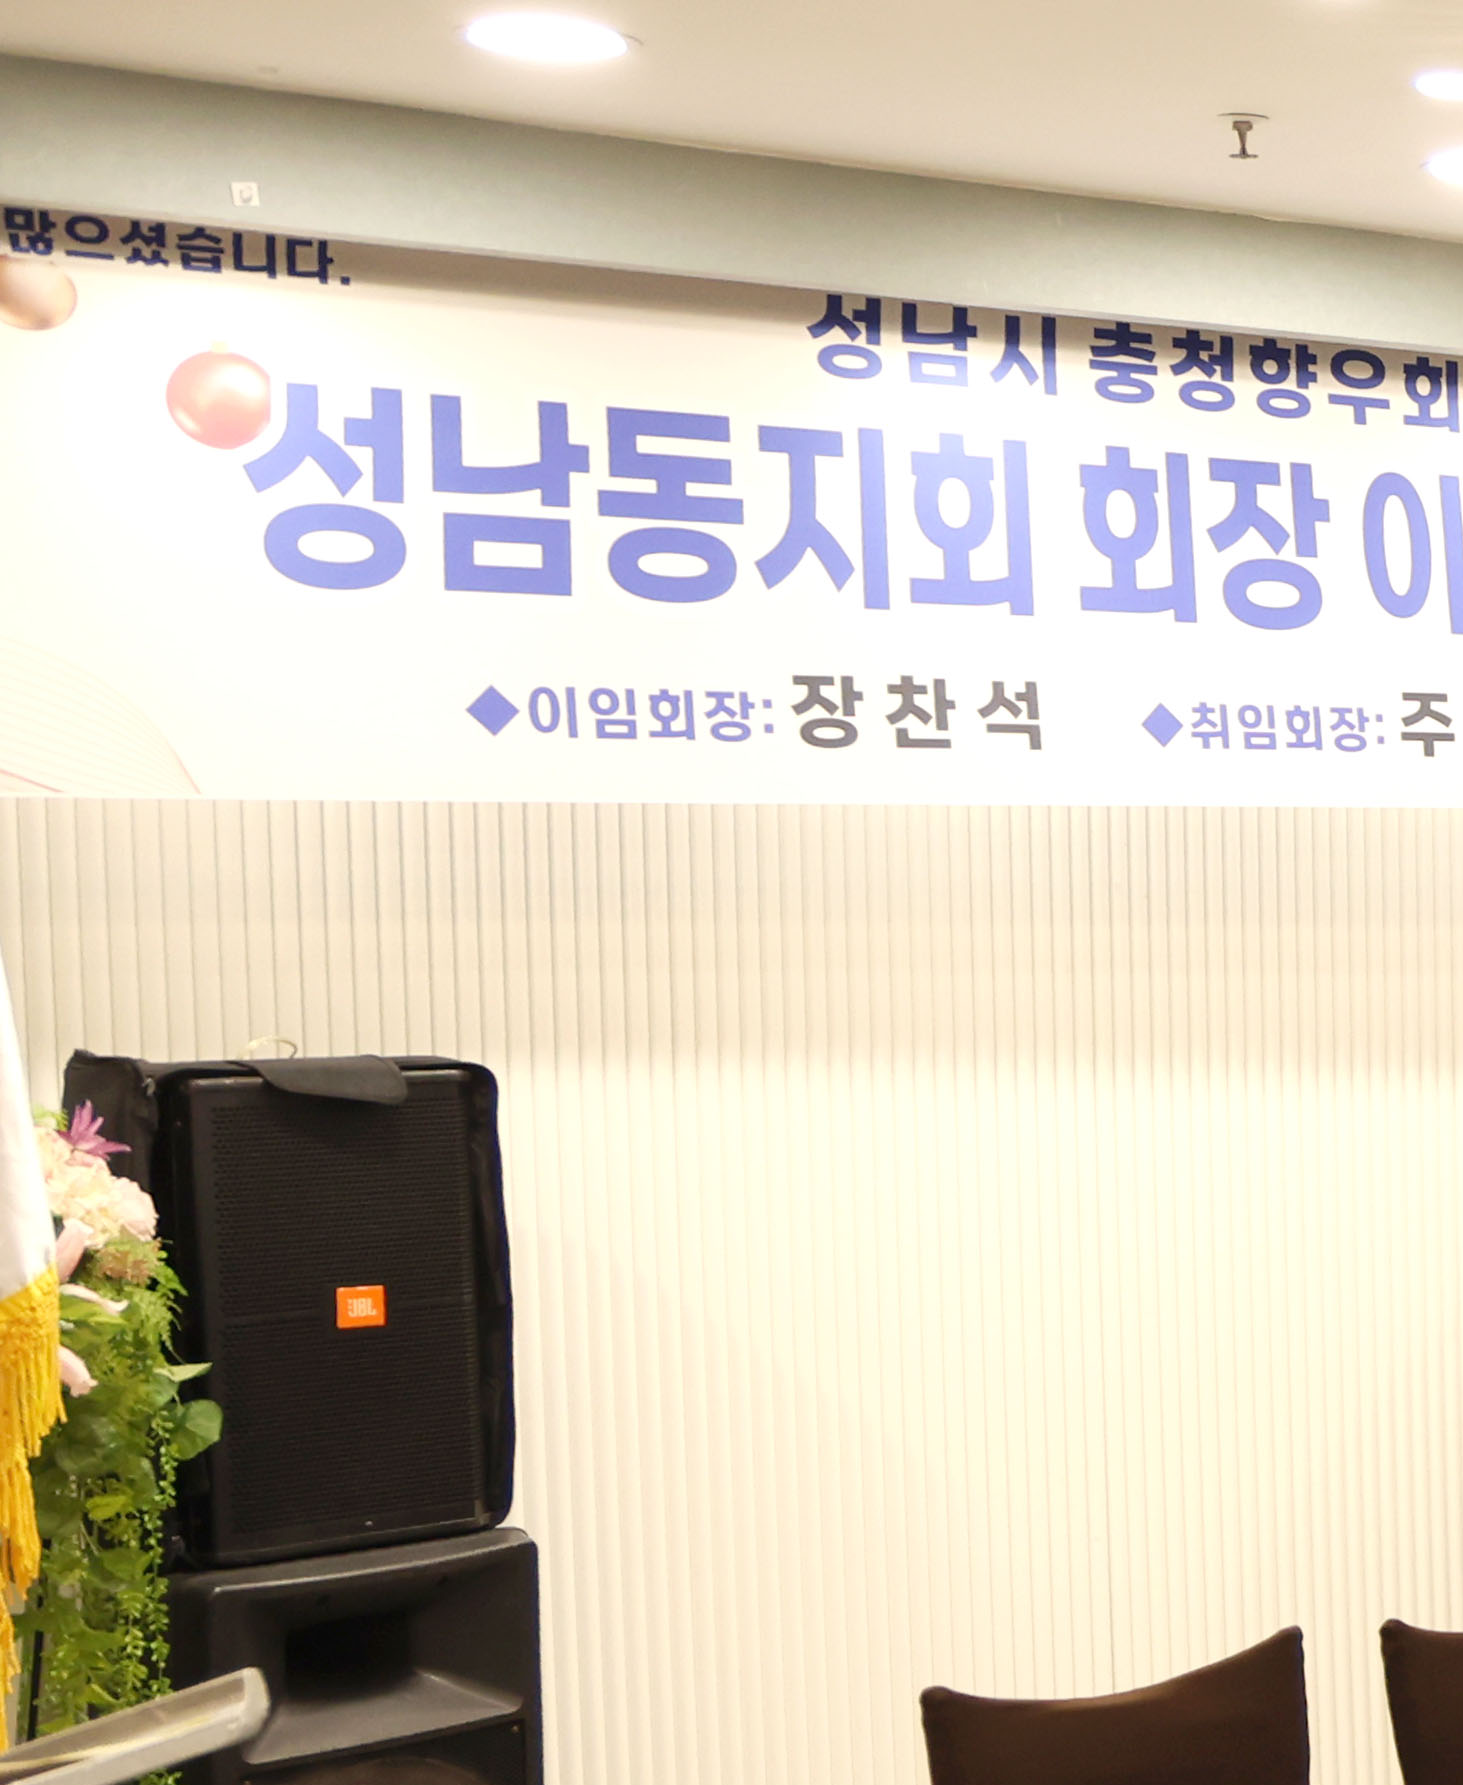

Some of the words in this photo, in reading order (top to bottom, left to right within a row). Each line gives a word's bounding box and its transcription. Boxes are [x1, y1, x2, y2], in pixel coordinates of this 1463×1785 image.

[4, 207, 350, 286] 많으셨습니다.
[807, 294, 1057, 396] 성남시
[1089, 322, 1460, 433] 충청향우회
[243, 381, 1034, 617] 성남동지회
[1078, 446, 1330, 631] 회장
[527, 685, 776, 744] 이임회장:
[1190, 701, 1386, 753] 취임회장:
[346, 1297, 377, 1318] JBL
